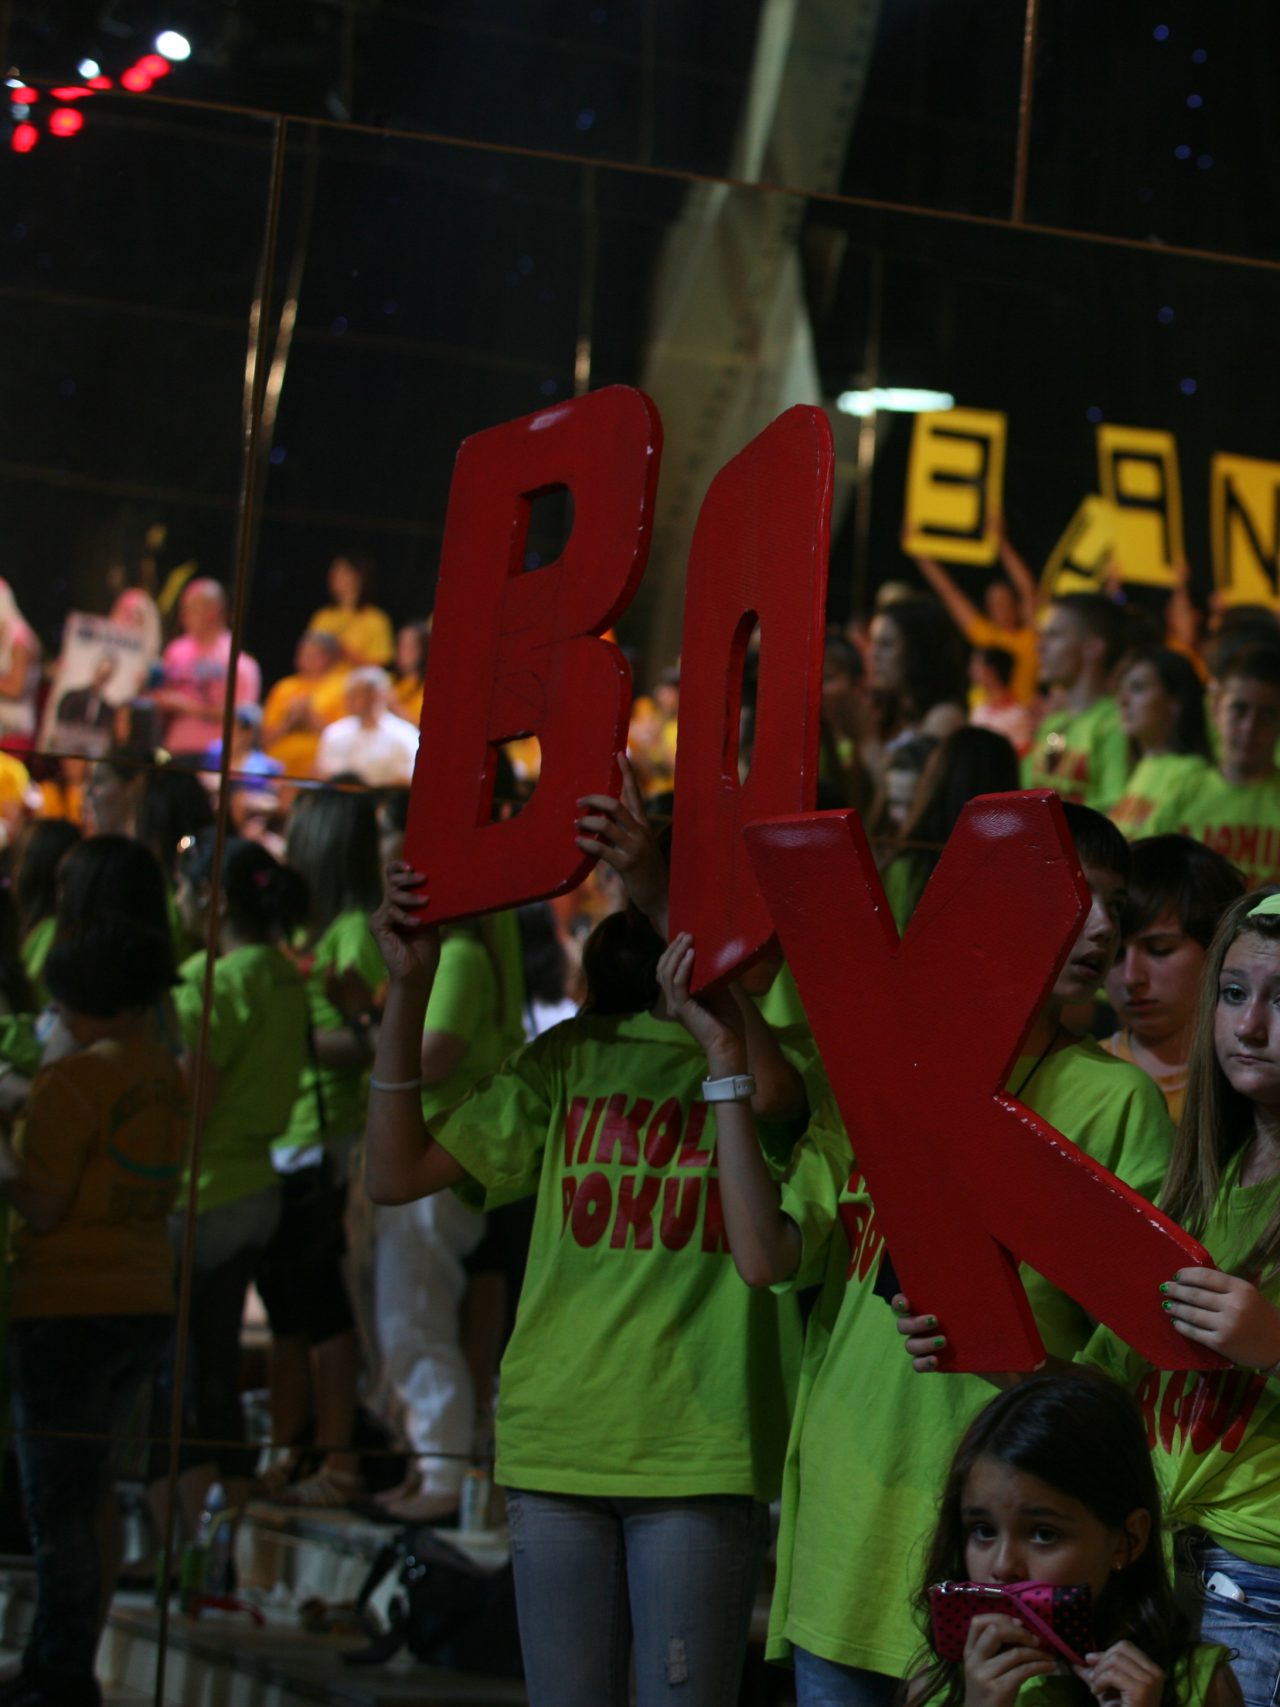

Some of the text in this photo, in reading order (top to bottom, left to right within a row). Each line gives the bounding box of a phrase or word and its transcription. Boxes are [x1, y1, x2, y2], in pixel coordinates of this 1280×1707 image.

[403, 384, 663, 928] B
[743, 788, 1234, 1374] K
[565, 1093, 718, 1168] IKOL
